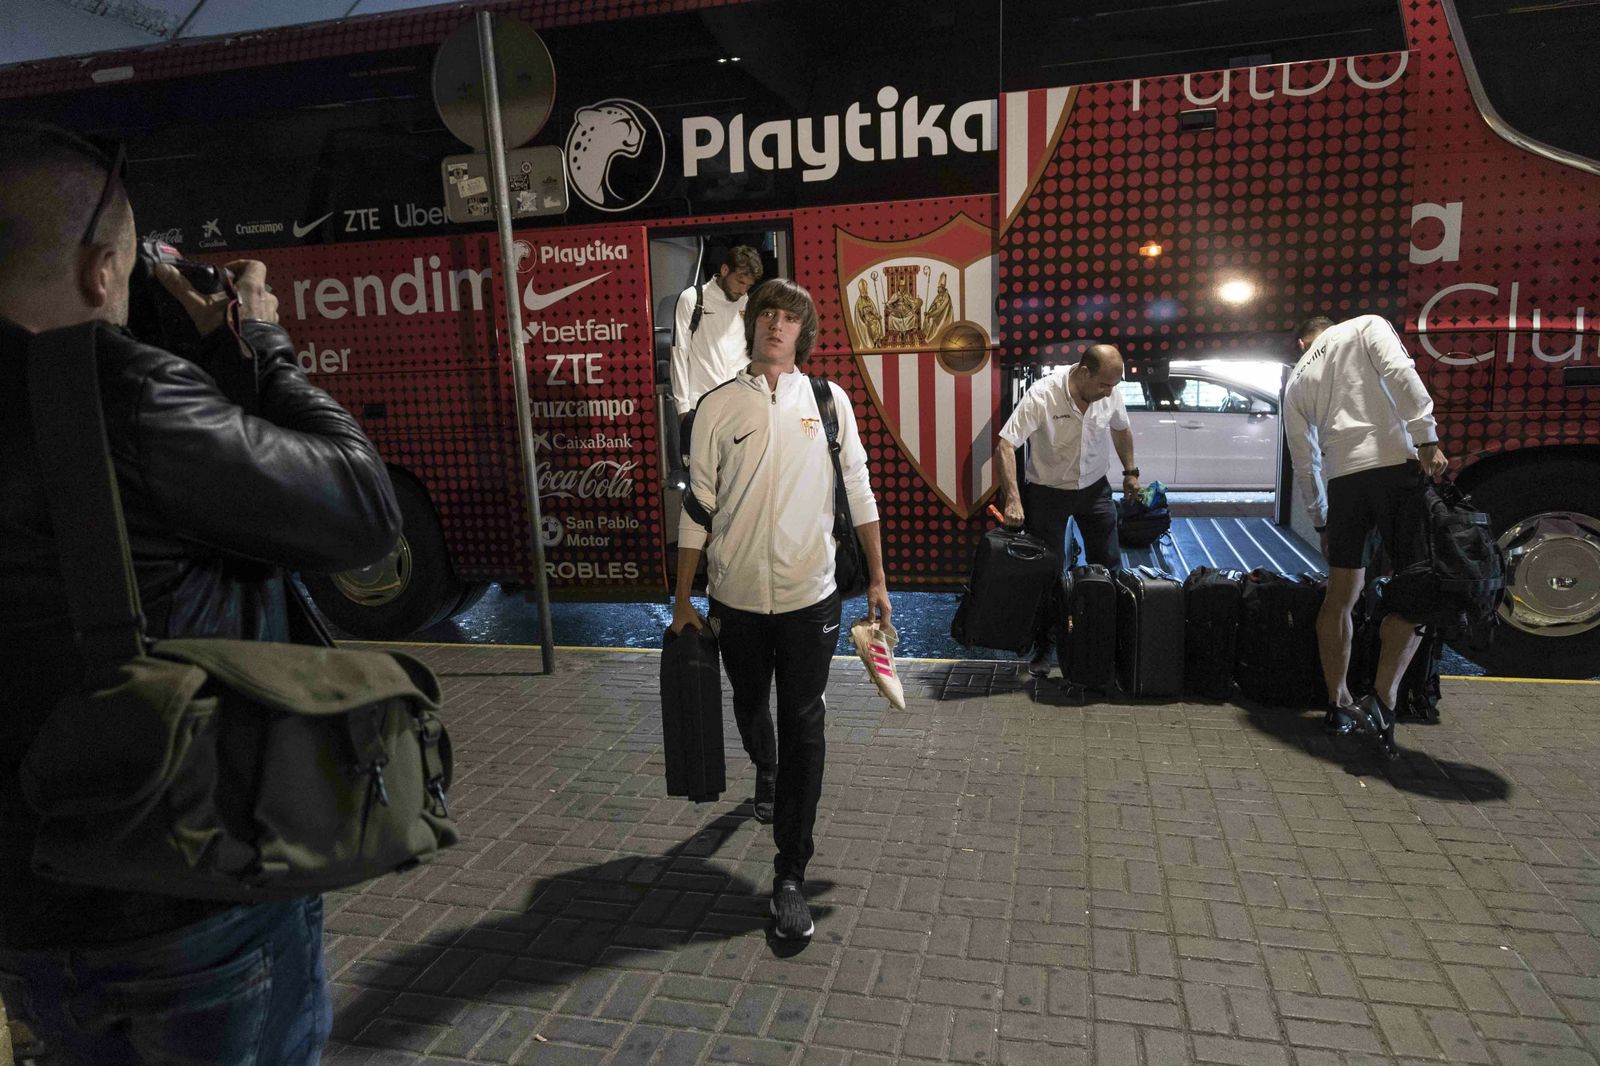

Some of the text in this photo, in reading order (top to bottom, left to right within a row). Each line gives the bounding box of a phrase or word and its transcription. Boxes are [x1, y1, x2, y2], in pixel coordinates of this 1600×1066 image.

[682, 85, 998, 182] Playtika
[235, 222, 285, 236] Cruzcampo
[343, 207, 381, 233] ZTE
[540, 239, 629, 267] Playtika
[542, 318, 629, 343] betfair
[1418, 281, 1600, 366] Clu
[546, 352, 605, 386] ZTE
[552, 433, 633, 450] CaixaBank
[566, 515, 595, 530] San
[597, 515, 640, 530] Pablo
[566, 533, 611, 547] Motor
